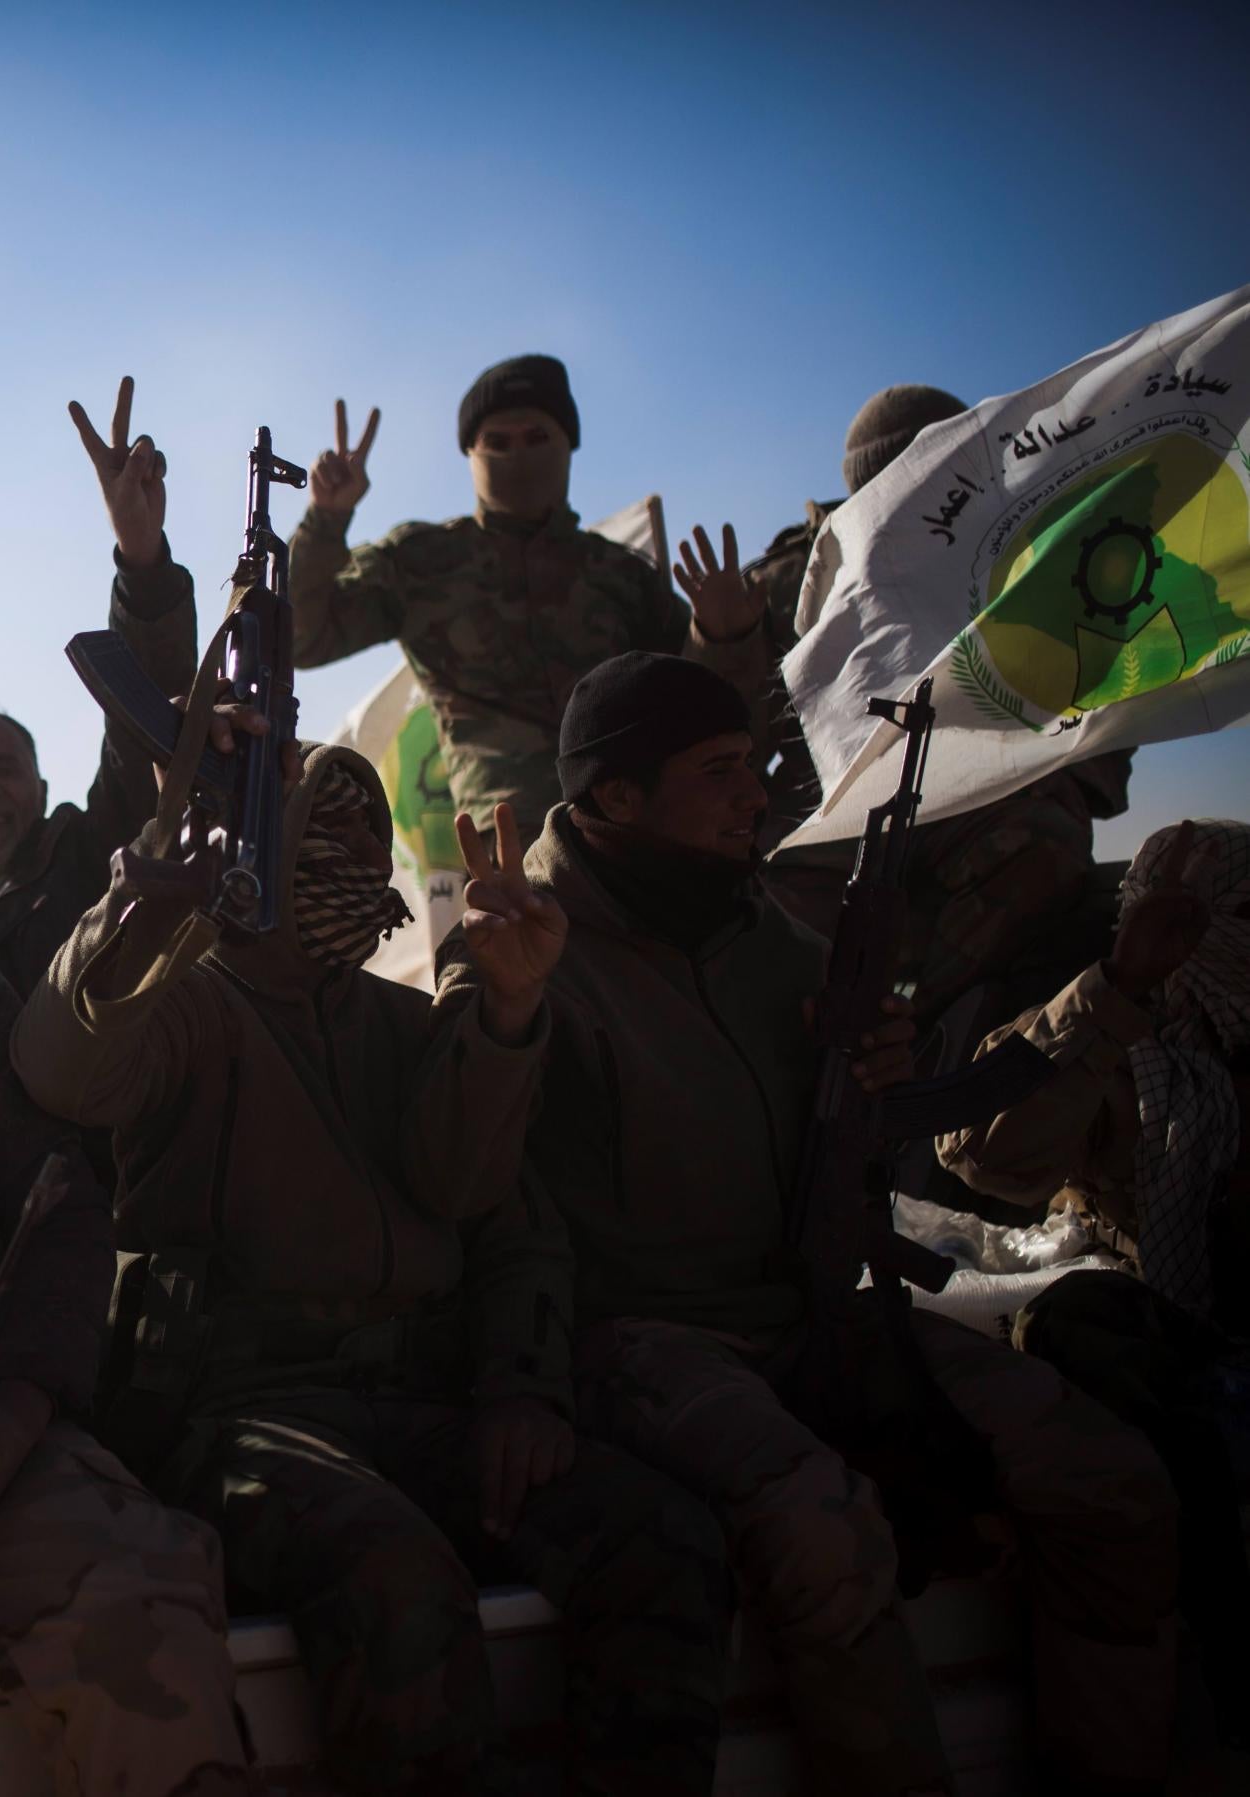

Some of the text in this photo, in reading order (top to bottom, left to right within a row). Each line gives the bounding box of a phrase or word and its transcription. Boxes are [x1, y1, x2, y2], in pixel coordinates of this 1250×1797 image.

[1143, 367, 1233, 398] سيادة
[998, 415, 1098, 462] عدالة
[921, 472, 986, 547] إعمار
